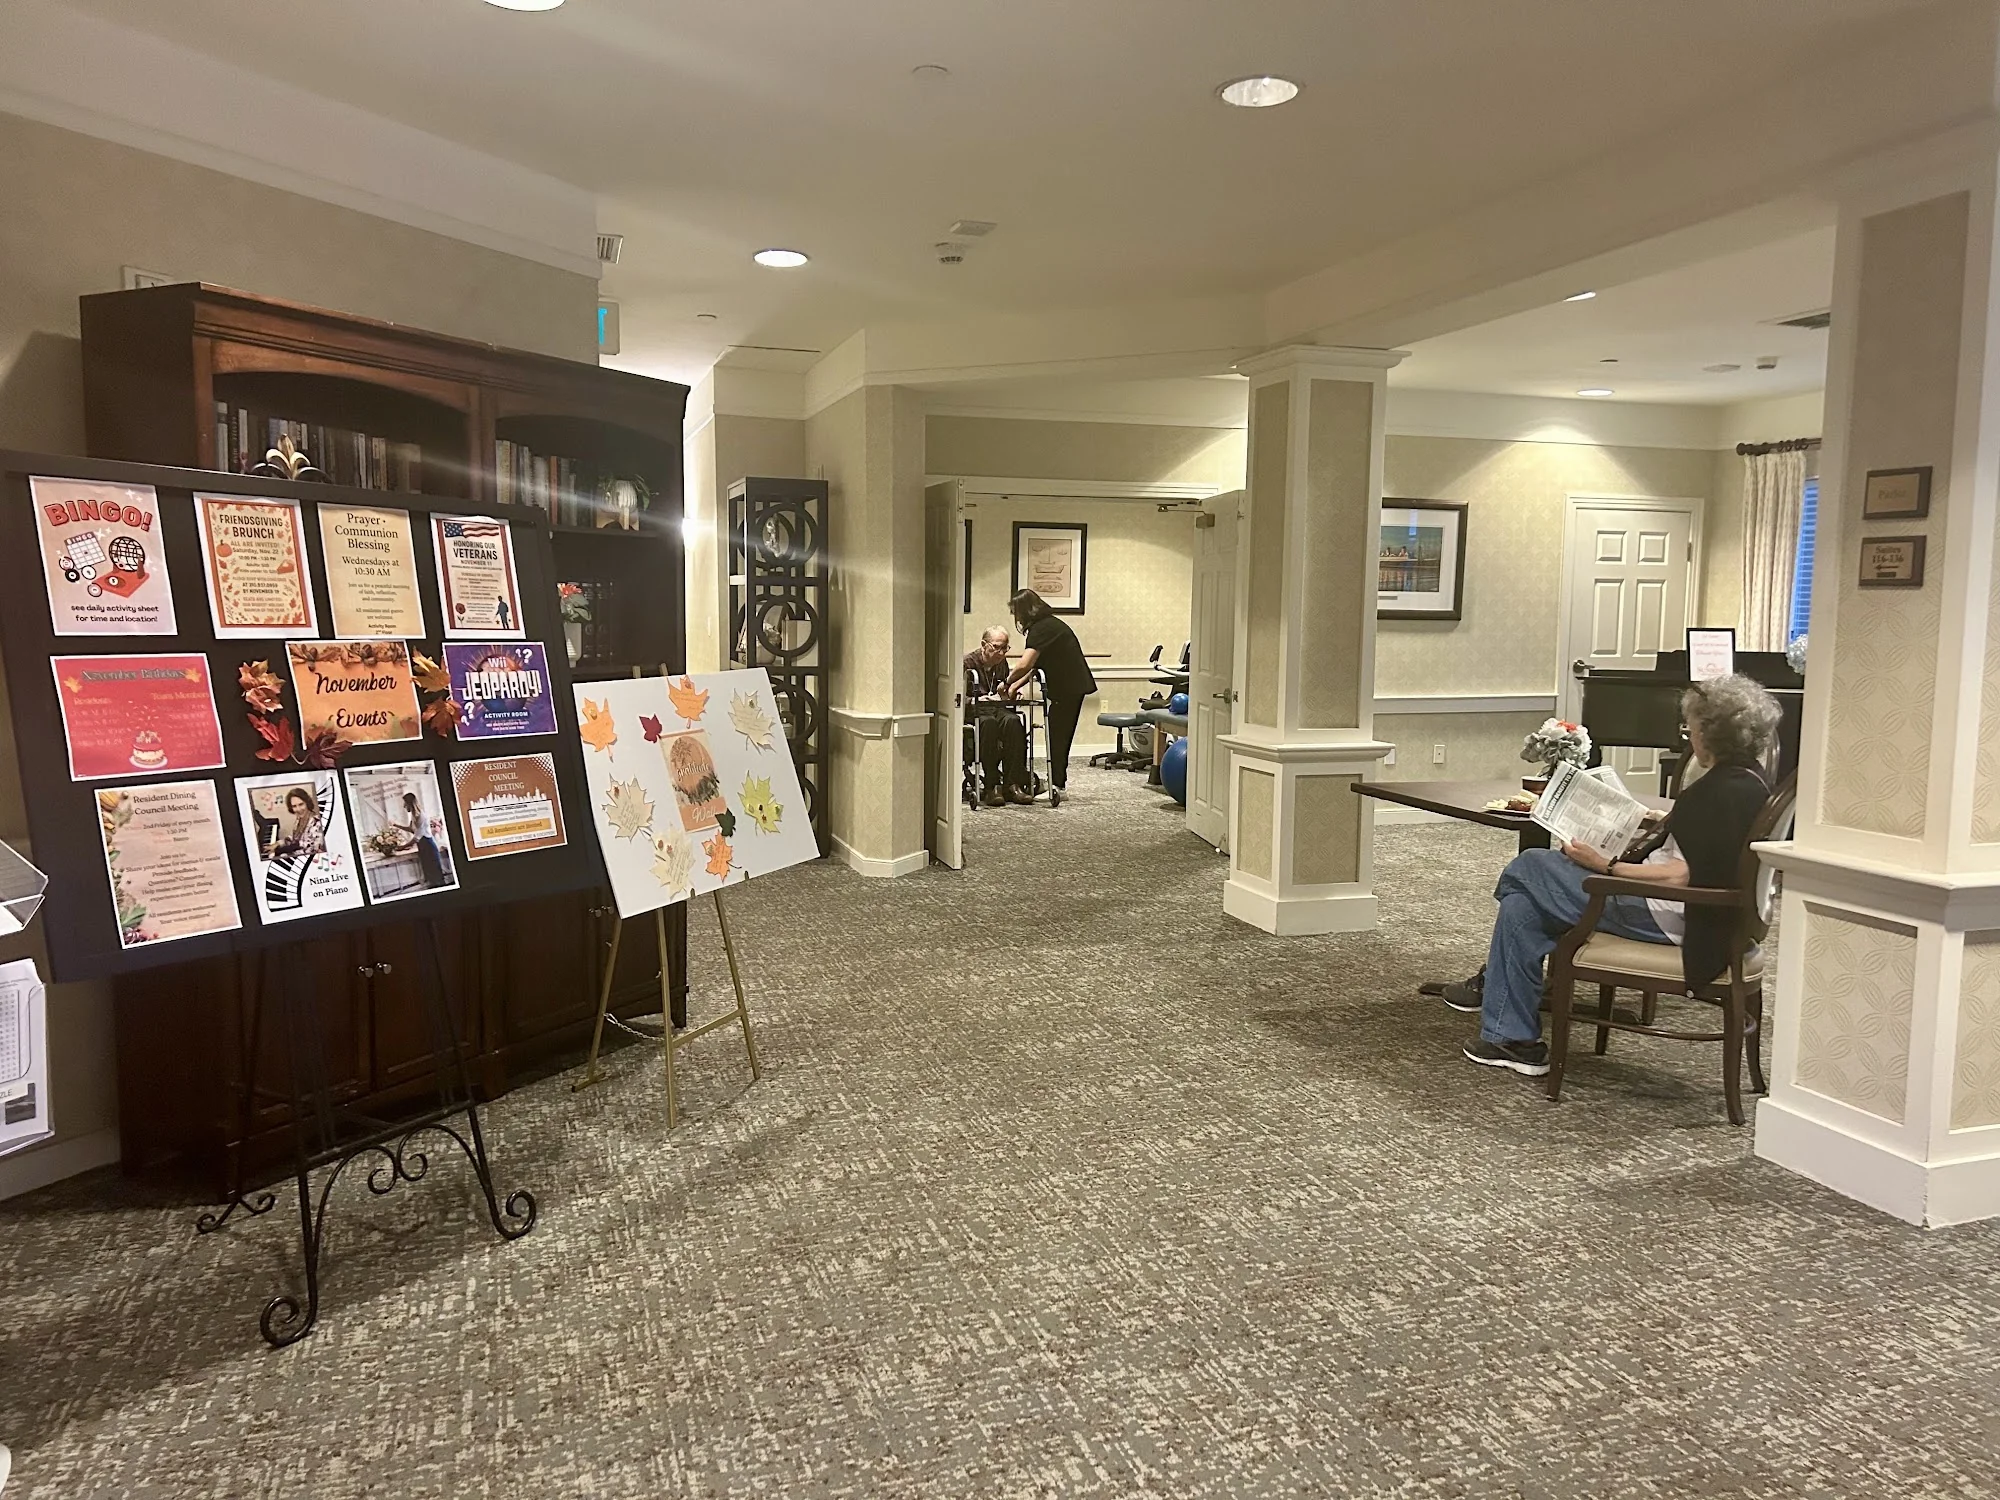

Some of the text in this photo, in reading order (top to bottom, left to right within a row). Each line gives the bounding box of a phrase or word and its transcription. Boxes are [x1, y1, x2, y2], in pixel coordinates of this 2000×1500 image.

[44, 499, 152, 532] BINGO!
[219, 515, 283, 527] FRIENDSGIVING
[347, 513, 380, 527] Prayer
[232, 527, 275, 539] BRUNCH
[335, 525, 399, 539] Communion
[66, 533, 93, 545] BINGO
[453, 540, 483, 549] HONORING
[348, 538, 391, 553] Blessing
[453, 548, 498, 560] VETERANS
[341, 556, 390, 568] Wednesdays
[355, 568, 375, 576] 10:30
[86, 604, 105, 613] daily
[106, 605, 137, 613] activity
[488, 657, 507, 668] Wii
[315, 672, 397, 695] November
[462, 670, 543, 700] JEOPARDY!
[336, 708, 387, 728] Events
[484, 761, 516, 771] RESIDENT
[676, 758, 709, 782] gratitude
[488, 772, 518, 782] COUNCIL
[493, 782, 525, 792] MEETING
[133, 791, 197, 804] Resident Dining
[134, 803, 199, 815] Council Meeting
[692, 806, 717, 823] Wall
[309, 873, 349, 886] Nina Live
[325, 886, 349, 896] Piano
